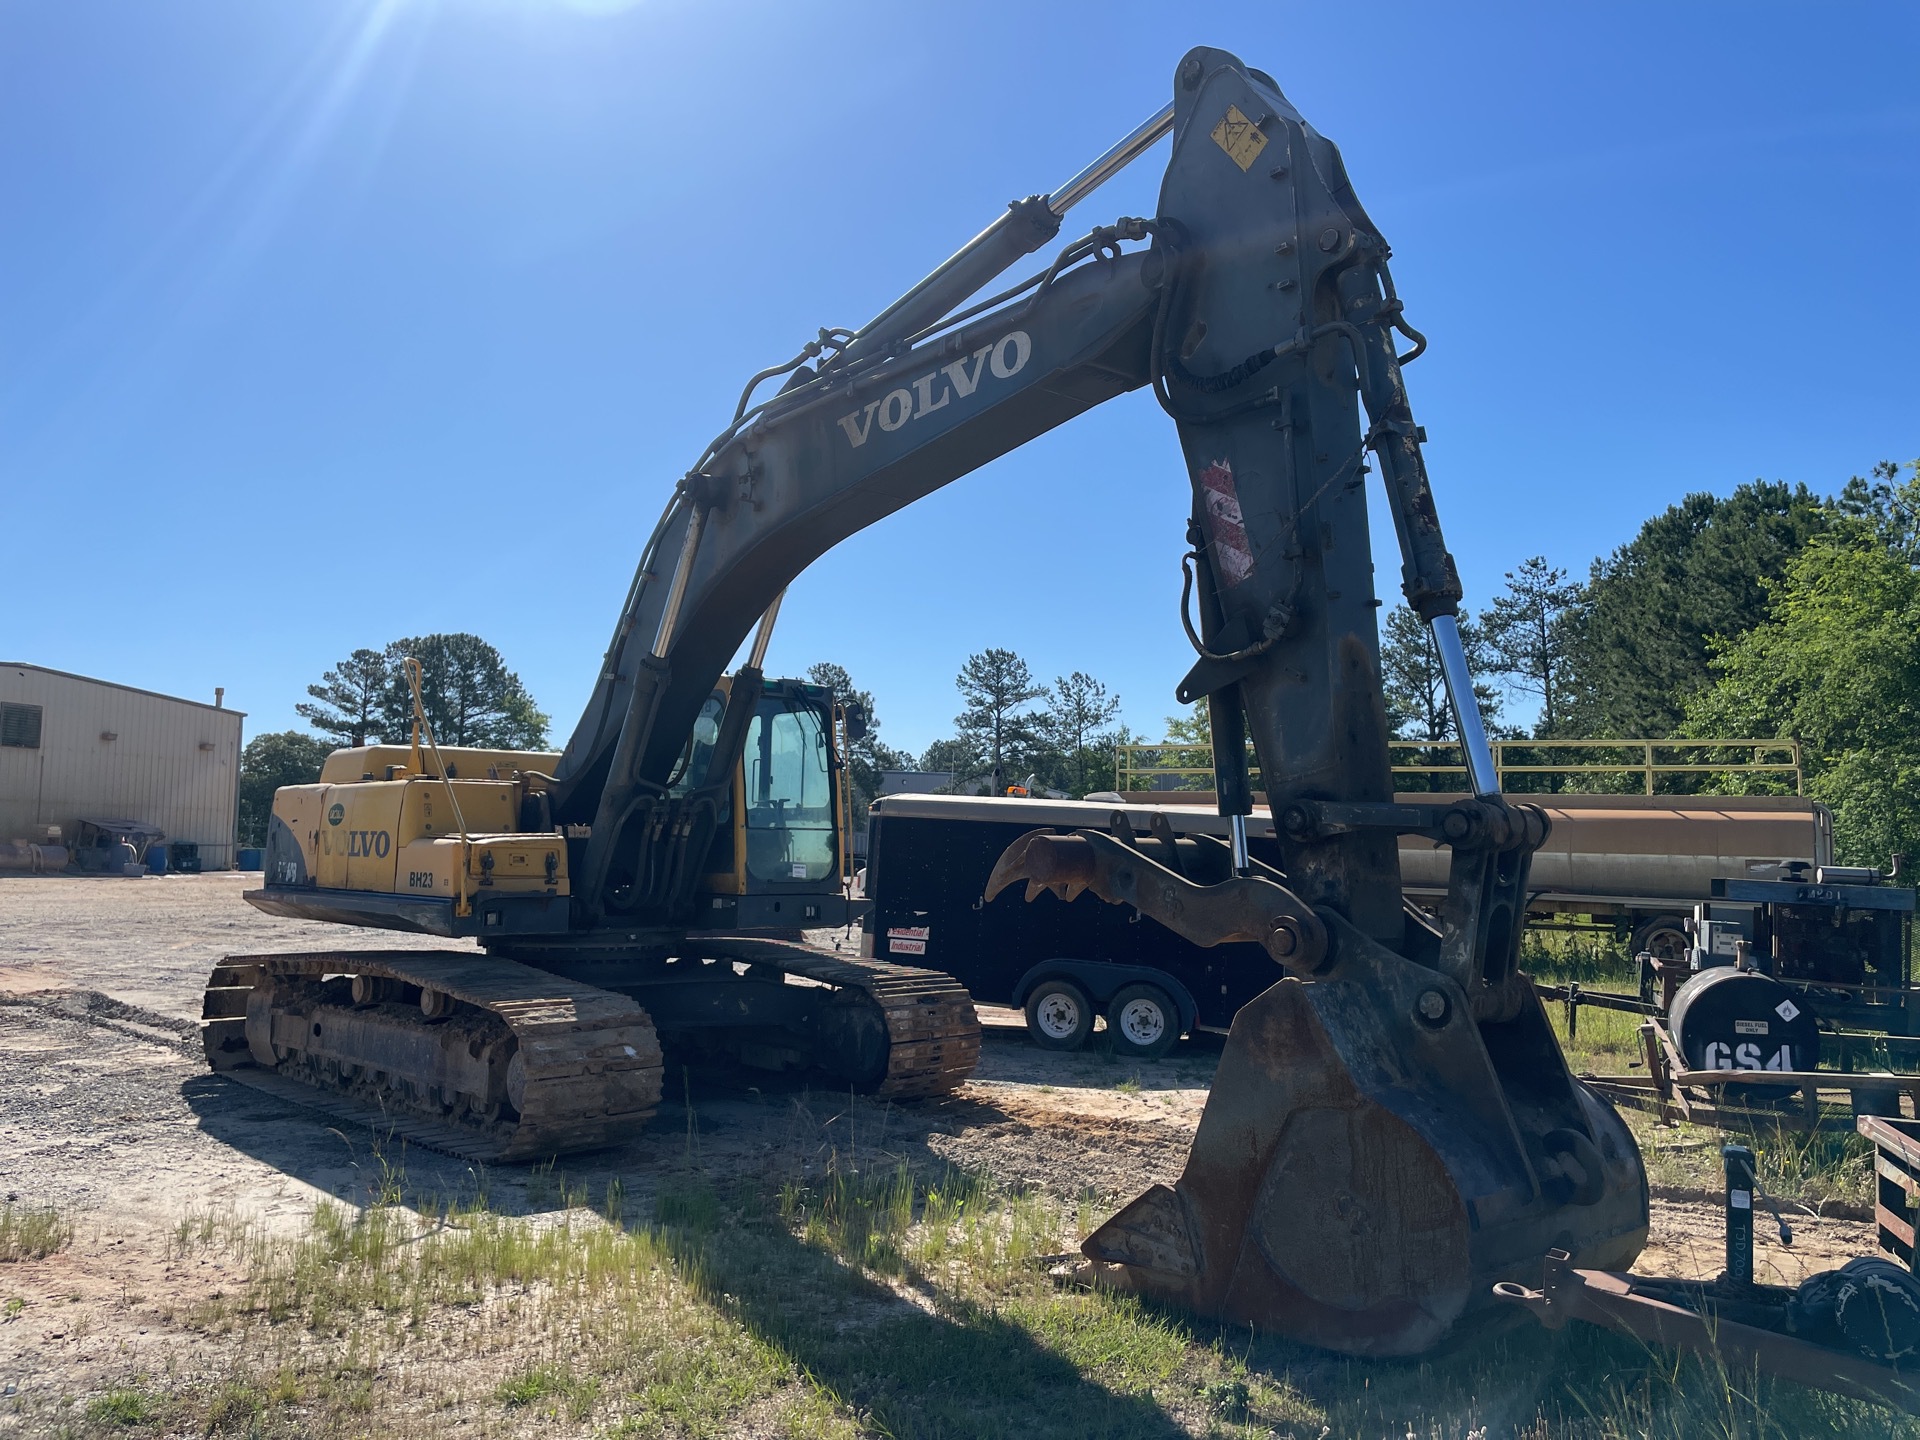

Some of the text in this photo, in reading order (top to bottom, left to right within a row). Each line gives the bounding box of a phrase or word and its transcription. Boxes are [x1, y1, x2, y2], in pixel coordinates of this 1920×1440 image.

[837, 330, 1032, 448] VOLVO
[321, 829, 391, 859] VOLVO
[409, 871, 434, 889] BH23
[891, 941, 924, 952] Industrial
[1705, 1041, 1794, 1072] GS4
